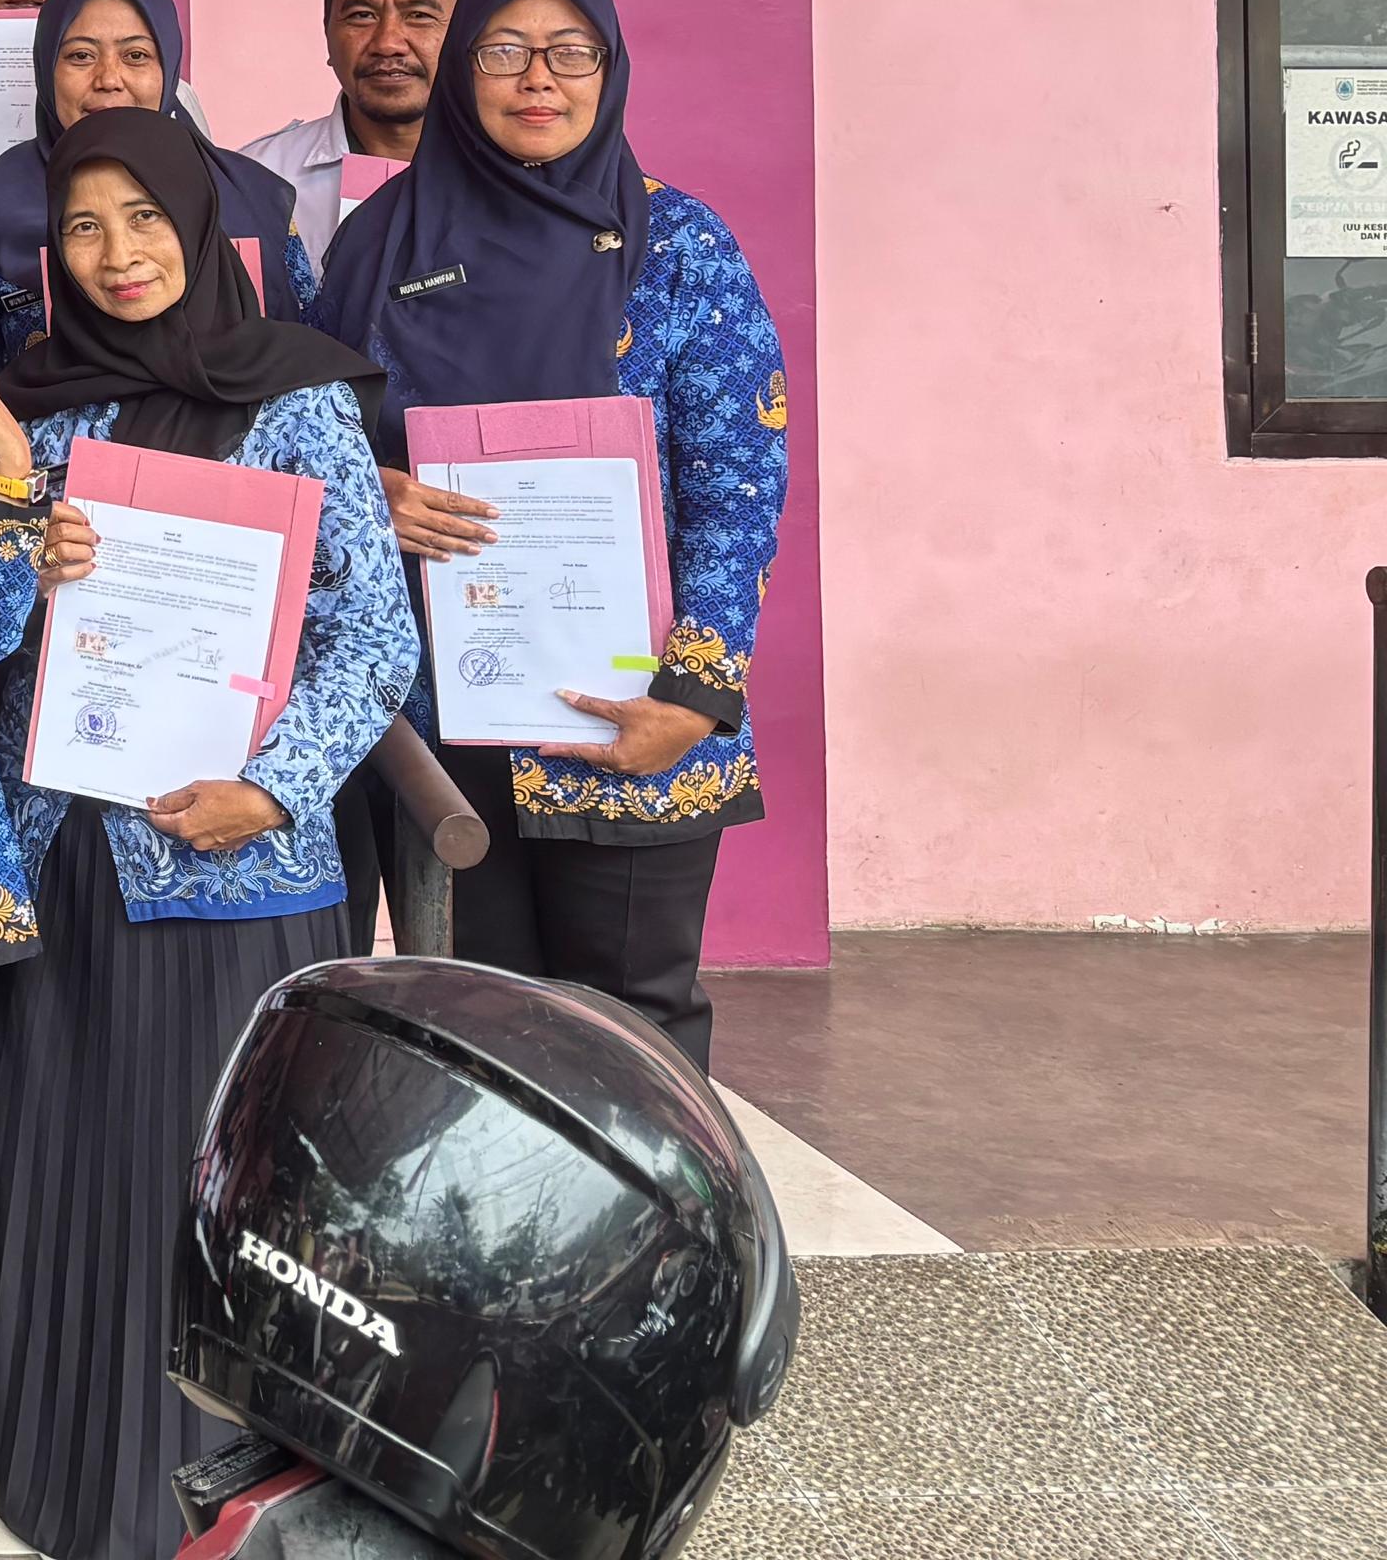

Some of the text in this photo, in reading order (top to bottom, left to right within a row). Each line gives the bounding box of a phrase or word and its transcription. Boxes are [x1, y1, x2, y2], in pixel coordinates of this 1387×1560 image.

[1342, 223, 1360, 233] (UU
[1361, 232, 1381, 241] DAN
[399, 281, 425, 295] RUSUL
[237, 1230, 403, 1357] HONDA
